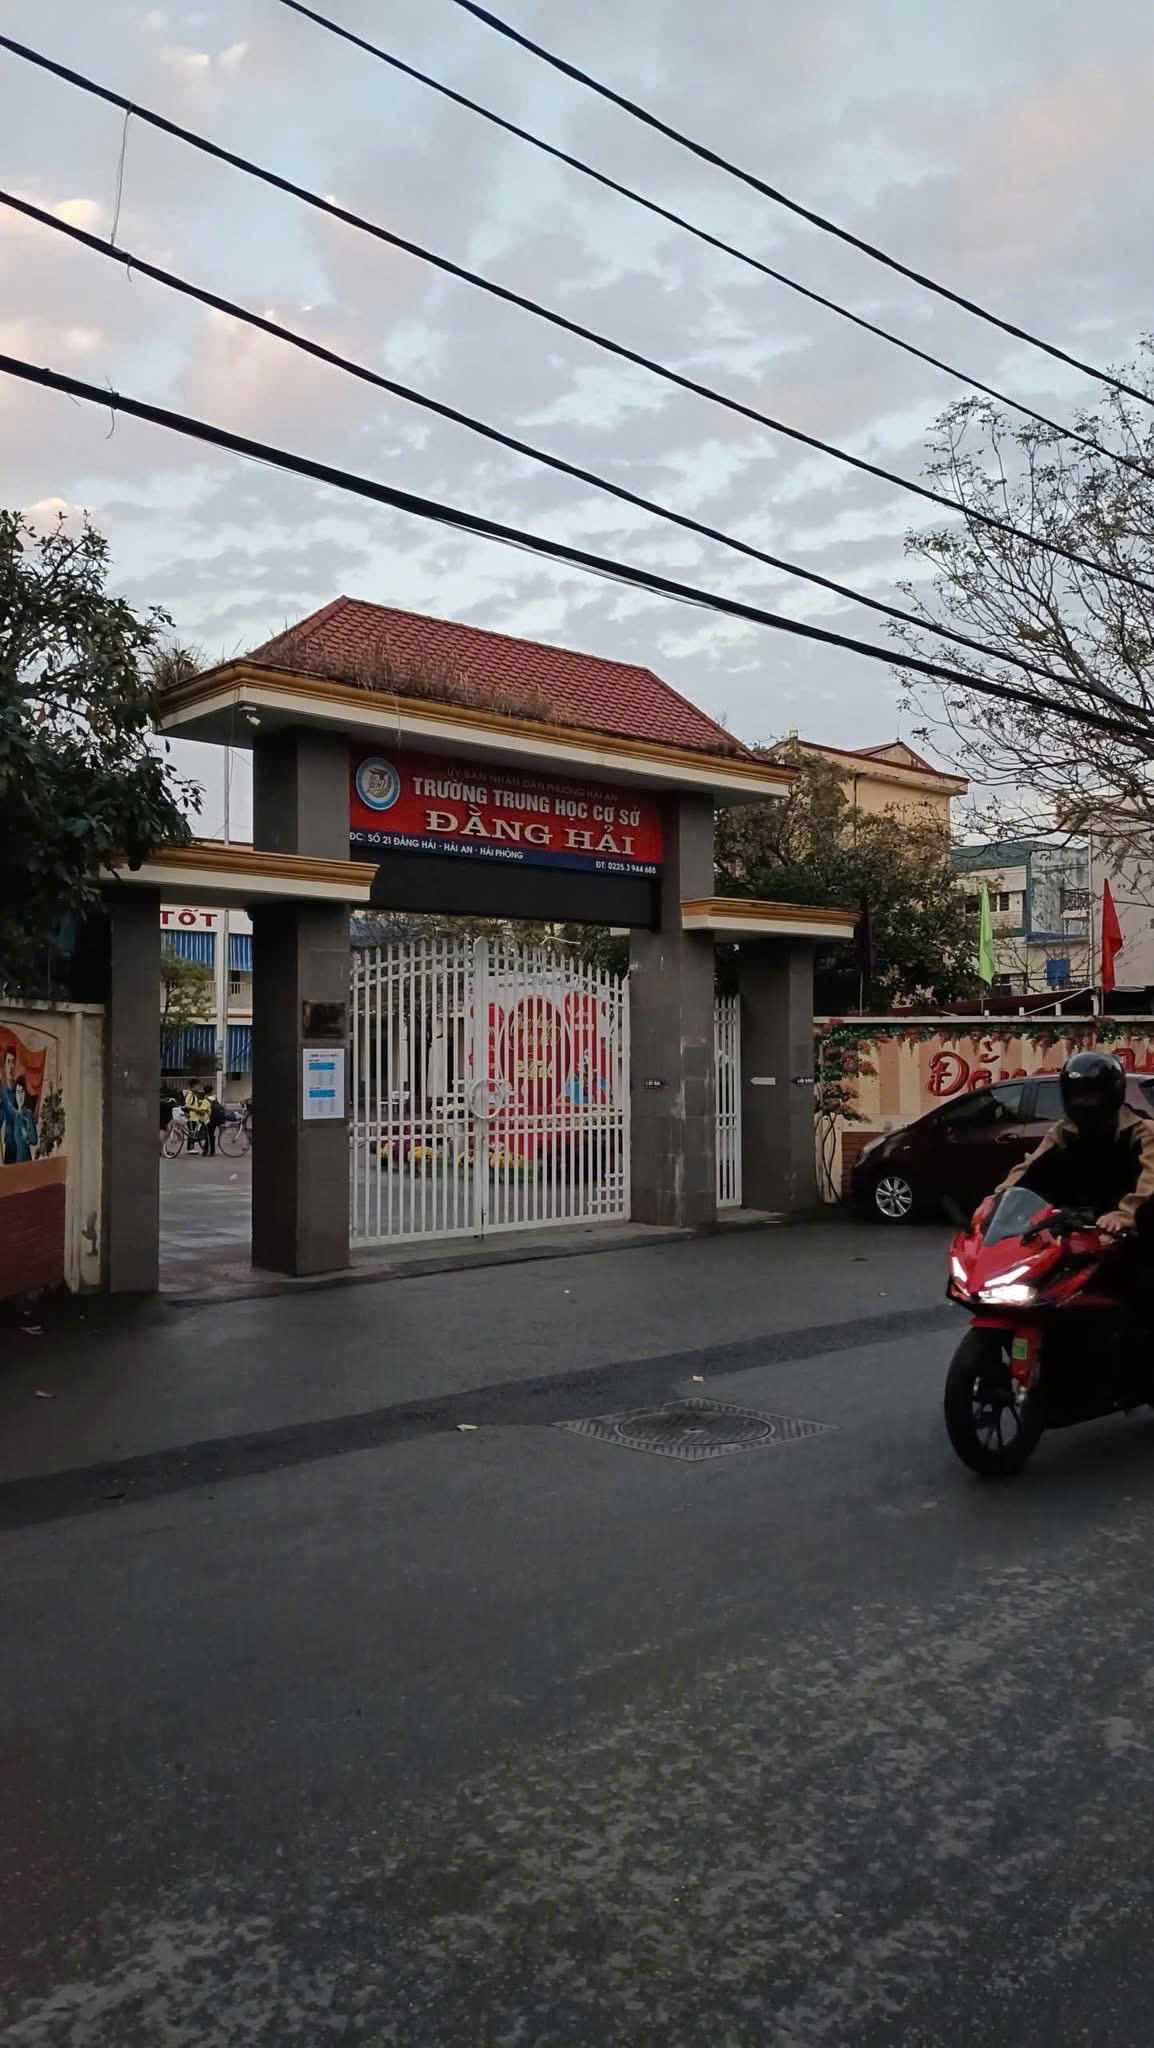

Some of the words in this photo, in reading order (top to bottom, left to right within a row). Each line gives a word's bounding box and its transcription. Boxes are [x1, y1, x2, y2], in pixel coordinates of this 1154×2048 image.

[412, 776, 488, 805] TRƯỜNG
[493, 789, 551, 814] TRUNG
[555, 798, 588, 821] HỌC
[593, 804, 616, 823] CƠ
[618, 803, 641, 827] SỞ
[367, 832, 381, 844] SỐ
[382, 836, 392, 845] 21
[421, 839, 437, 850] HẢI
[444, 841, 459, 852] HẢI
[460, 843, 473, 854] AN
[480, 846, 494, 856] HẢI
[495, 847, 524, 860] PHÒNG
[425, 803, 554, 846] ĐẰNG
[563, 824, 636, 856] HẢI
[160, 908, 218, 927] TỐT
[928, 1040, 1061, 1097] Đằ
